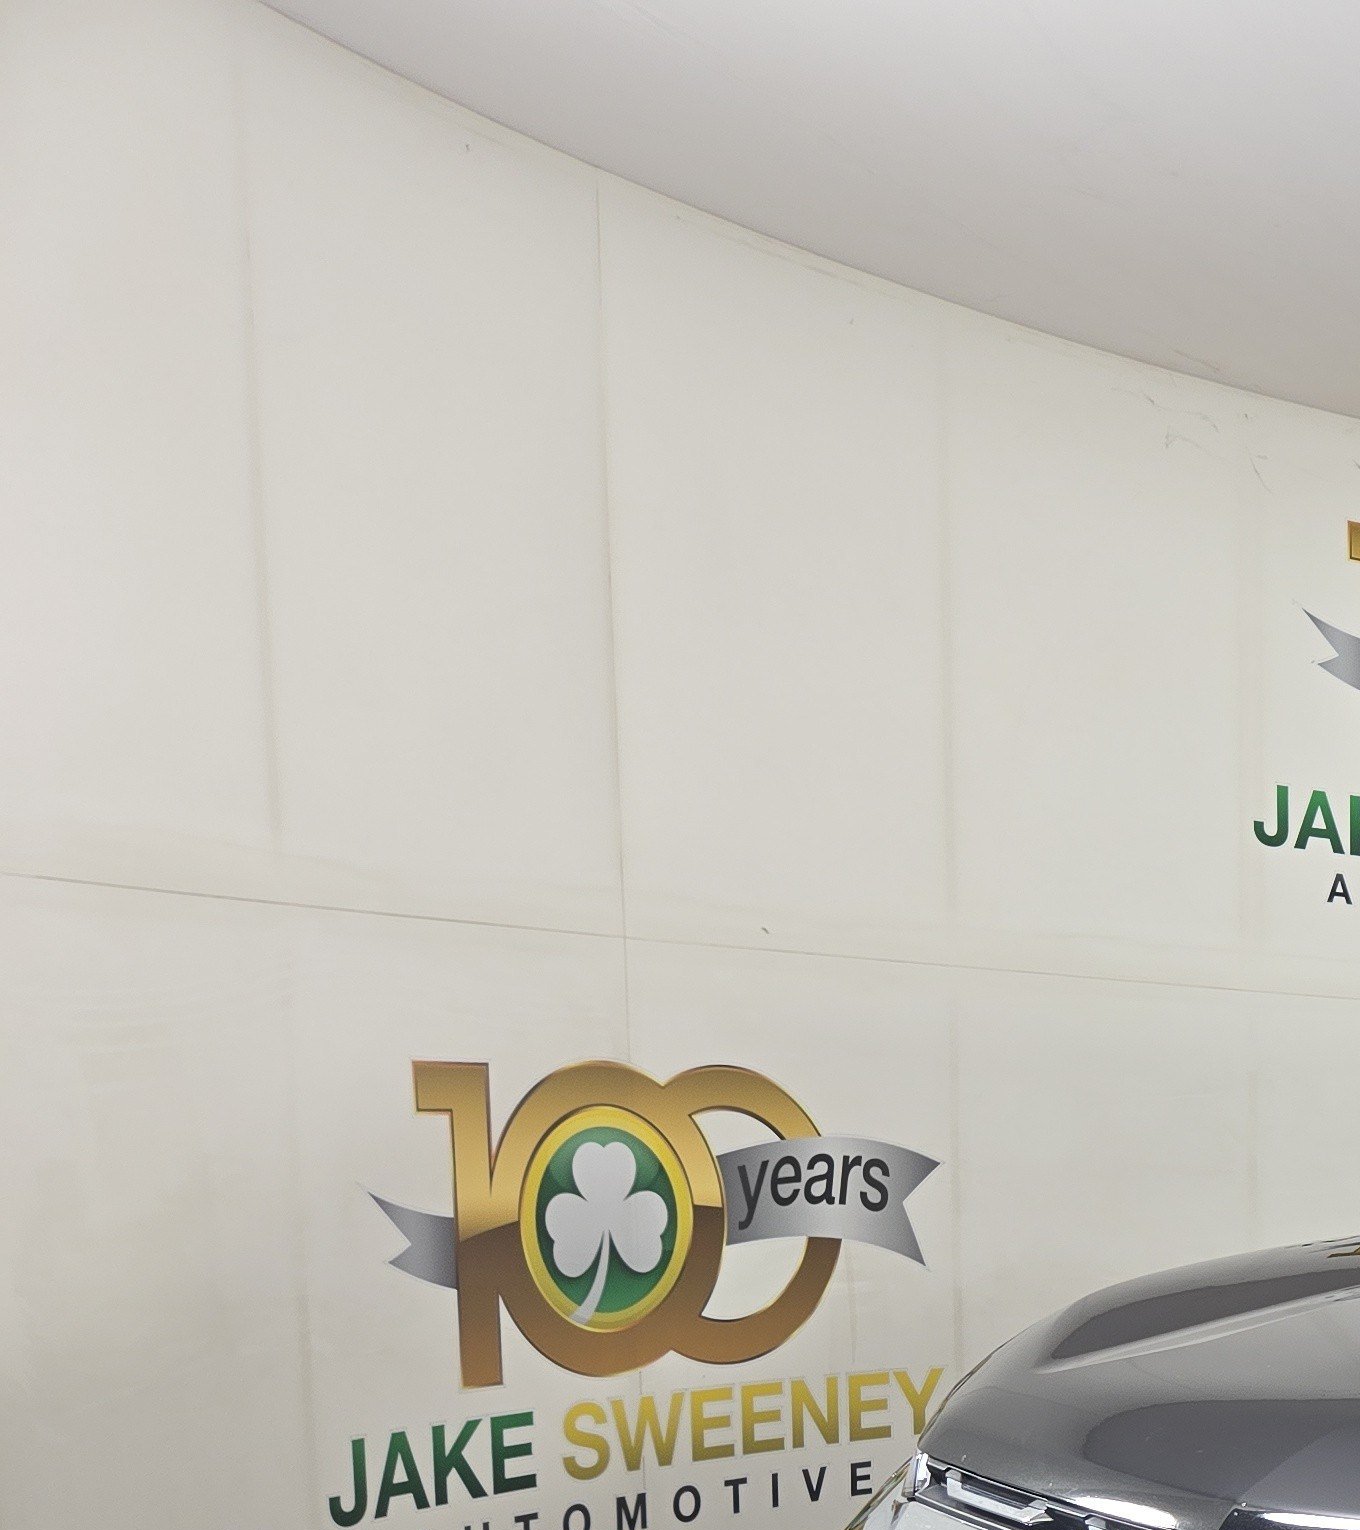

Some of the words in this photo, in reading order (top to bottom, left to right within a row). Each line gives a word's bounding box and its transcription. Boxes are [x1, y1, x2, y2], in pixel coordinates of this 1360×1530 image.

[411, 1058, 843, 1390] 100
[736, 1152, 891, 1230] years
[328, 1410, 538, 1528] JAKE
[562, 1367, 946, 1481] SWEENEY
